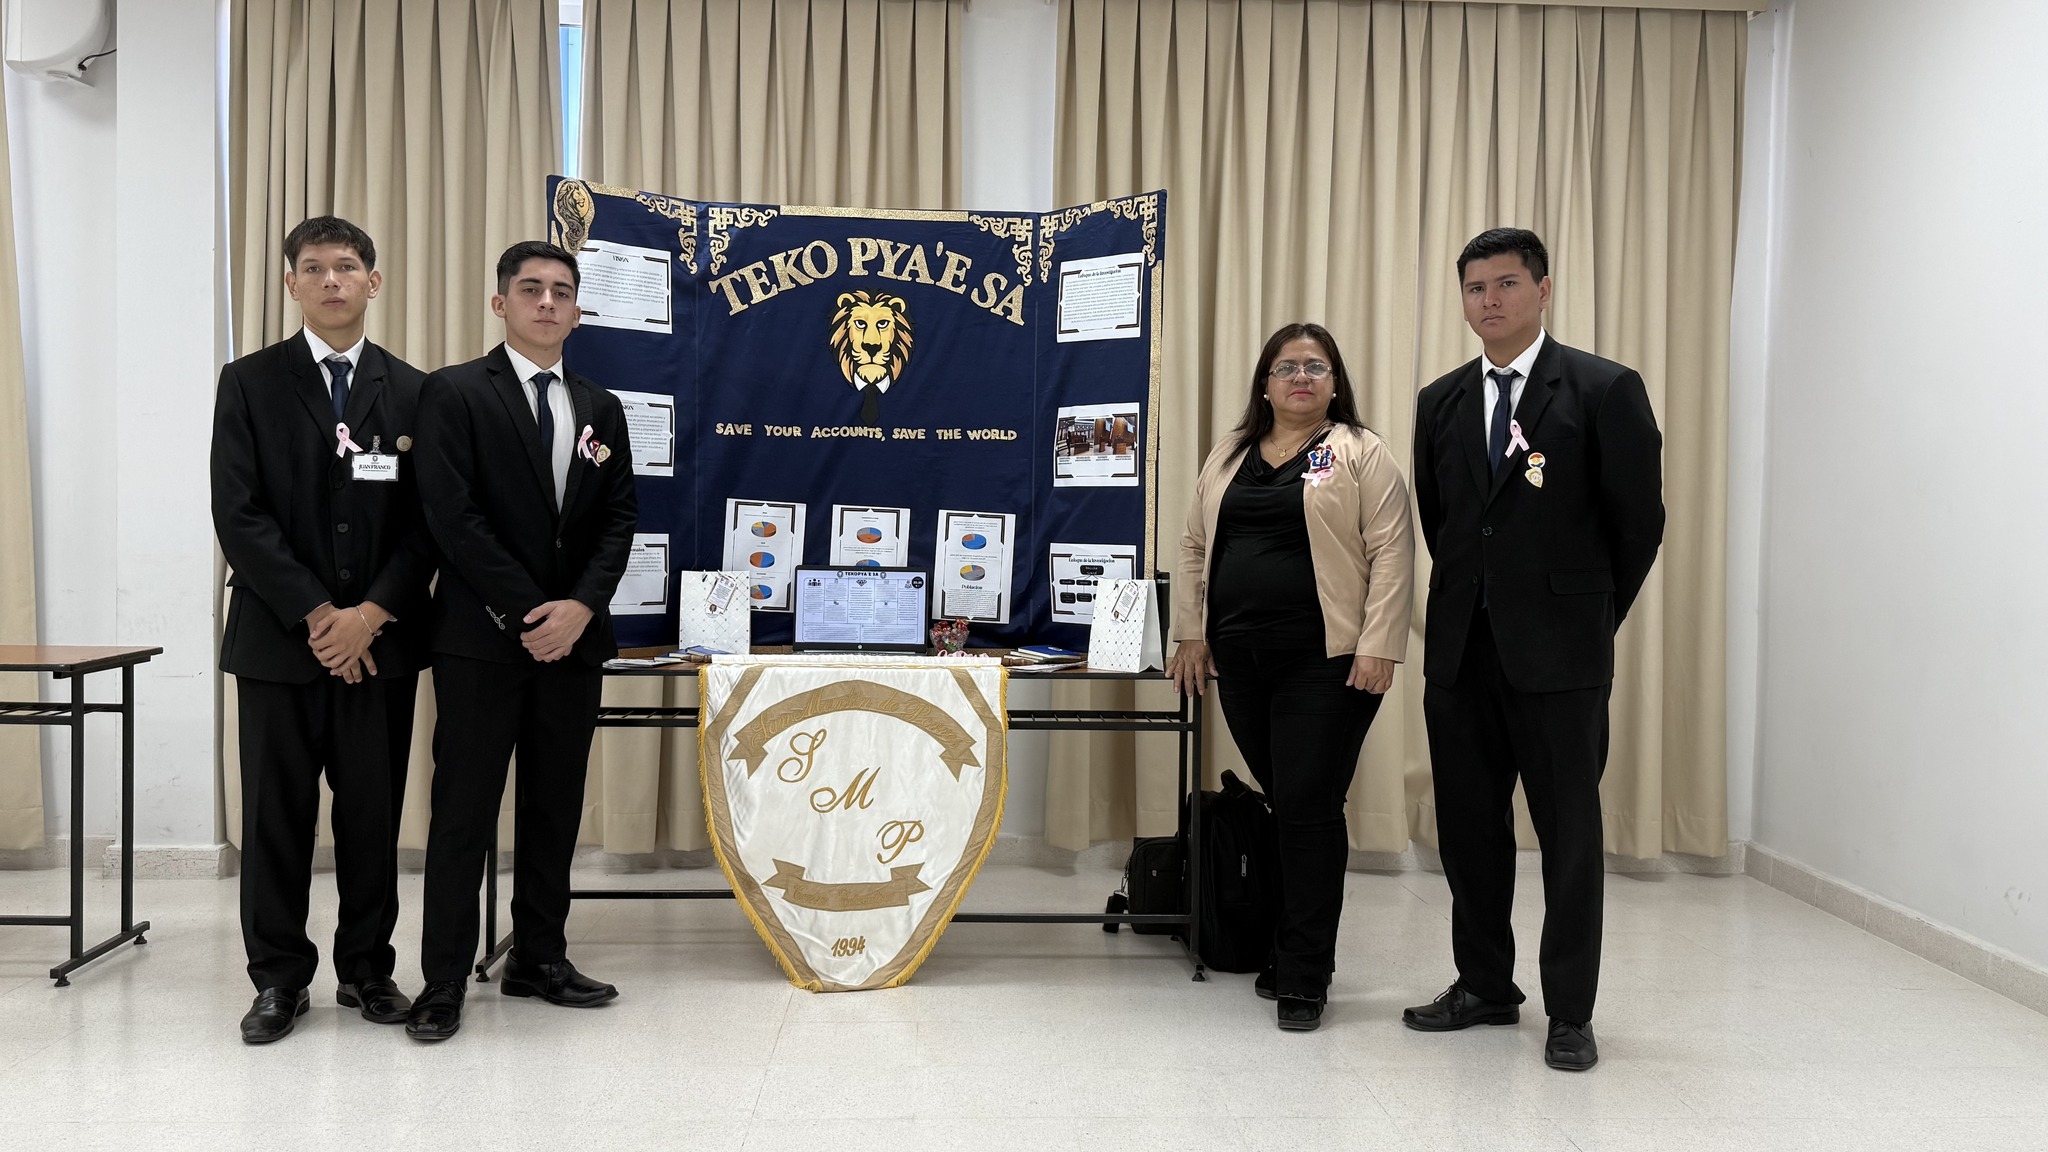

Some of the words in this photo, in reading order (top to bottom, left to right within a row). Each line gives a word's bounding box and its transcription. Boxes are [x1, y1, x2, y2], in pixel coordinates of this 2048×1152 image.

[708, 239, 838, 317] TEKO
[847, 237, 973, 295] PYA'E
[971, 272, 1026, 327] SA
[715, 423, 753, 436] SAVE
[764, 424, 803, 437] YOUR
[810, 426, 886, 441] ACCOUNTS,
[892, 428, 926, 440] SAVE
[936, 428, 962, 440] THE
[966, 429, 1018, 441] WORLD
[879, 691, 898, 711] de
[777, 728, 827, 783] S
[810, 766, 881, 813] M
[876, 820, 925, 864] P
[831, 936, 866, 957] 1994
